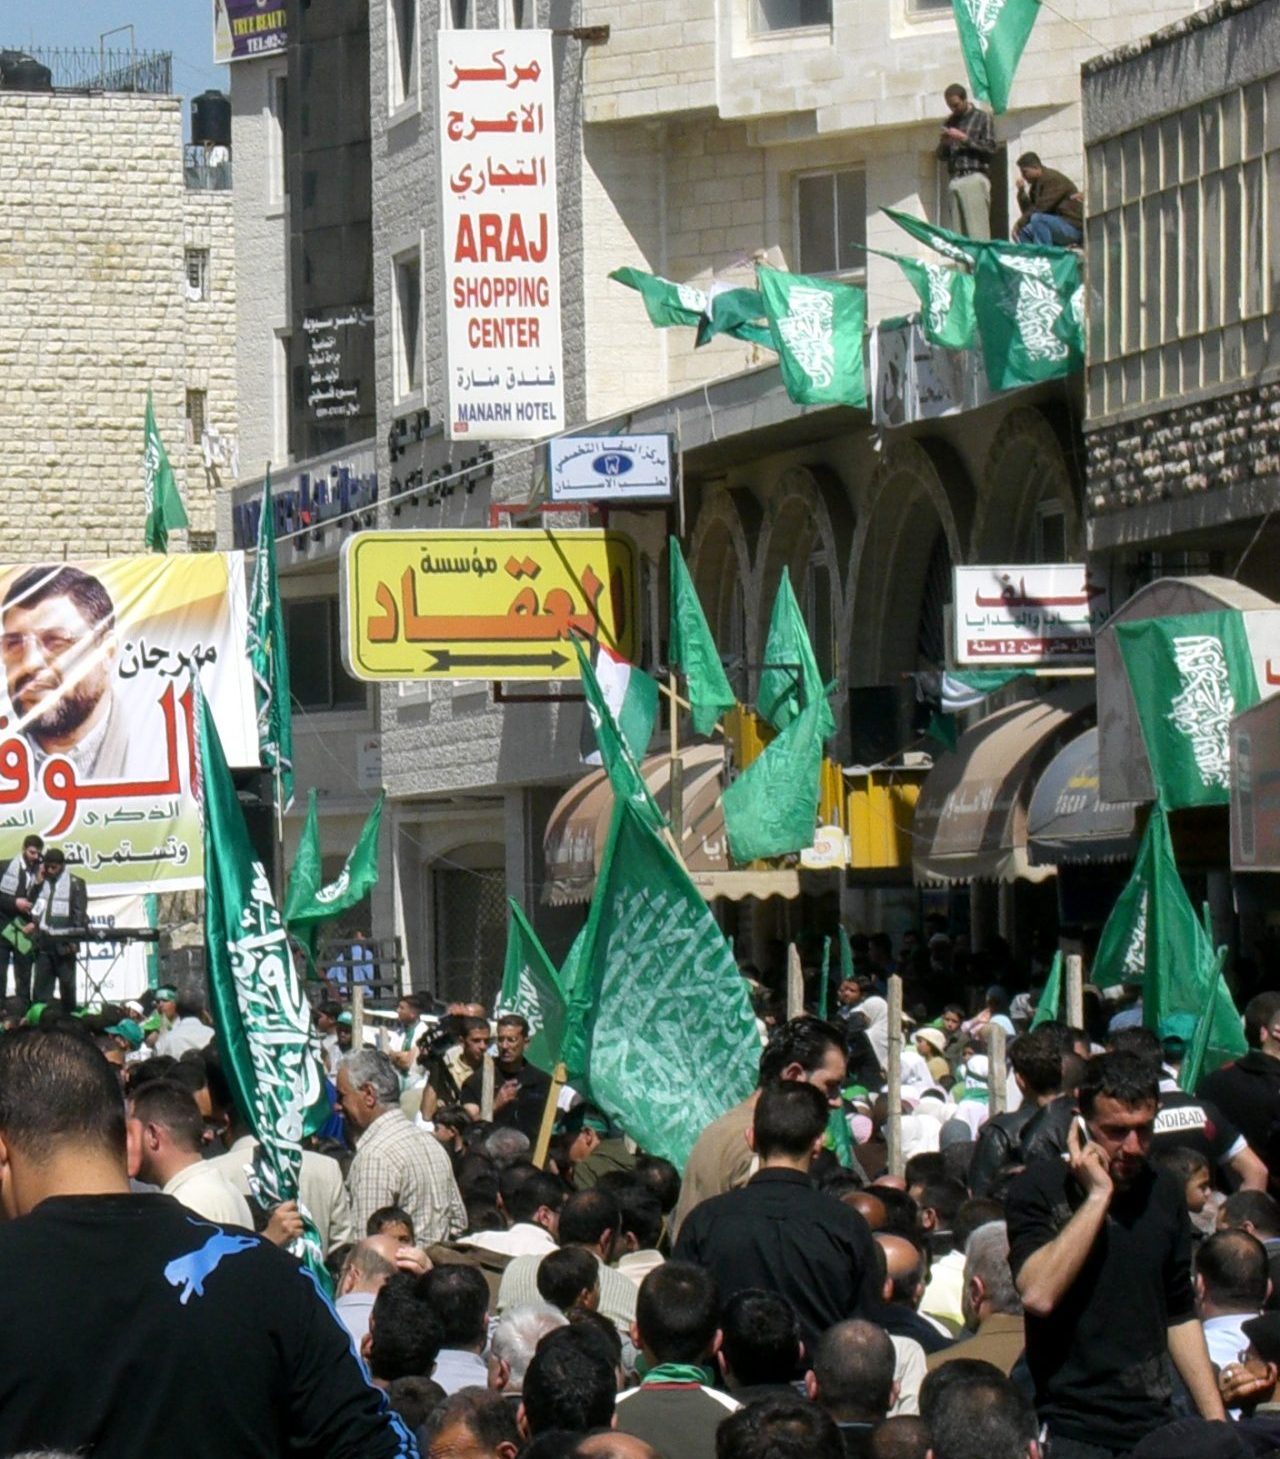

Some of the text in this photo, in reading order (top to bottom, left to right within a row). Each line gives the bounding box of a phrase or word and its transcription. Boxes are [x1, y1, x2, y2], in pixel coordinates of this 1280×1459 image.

[447, 49, 542, 90] مركز
[447, 102, 543, 142] الاعرج
[450, 155, 547, 200] التجاري
[454, 213, 548, 263] ARAJ
[453, 276, 550, 308] SHOPPING
[468, 317, 540, 348] CENTER
[457, 365, 556, 390] فندق منارة
[457, 402, 557, 422] MANARH HOTEL
[420, 547, 498, 578] مؤسسة
[366, 555, 625, 645] العقاد
[118, 640, 218, 680] مهرجان
[999, 641, 1017, 653] 12
[83, 801, 181, 827] الذكرى
